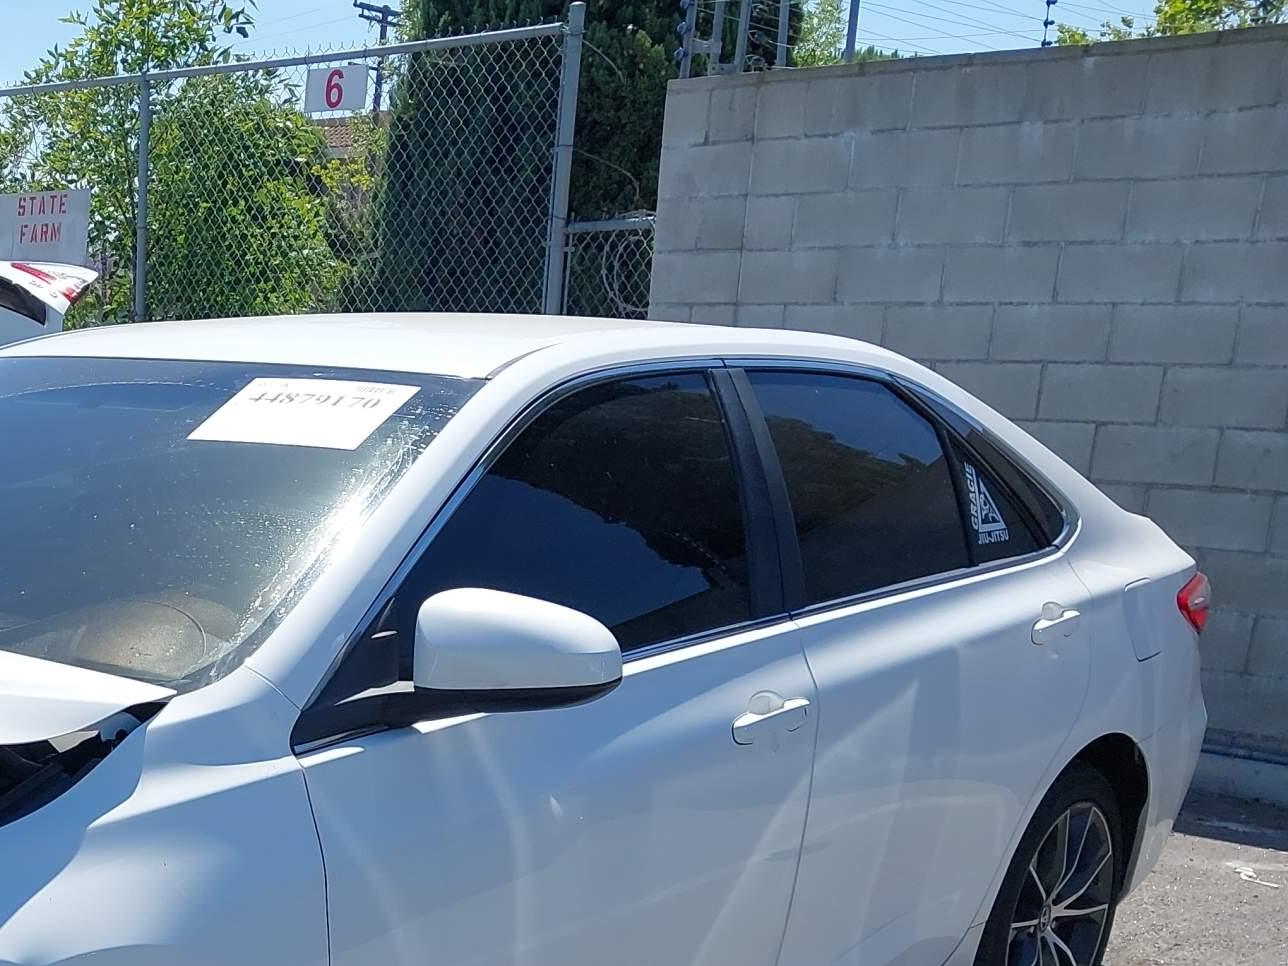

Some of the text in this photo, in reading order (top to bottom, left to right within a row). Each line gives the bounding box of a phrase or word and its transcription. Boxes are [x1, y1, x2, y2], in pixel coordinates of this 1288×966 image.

[325, 69, 344, 109] 6
[18, 194, 68, 217] STATE
[19, 222, 62, 244] FARM
[248, 391, 382, 409] 44879170
[964, 461, 978, 531] GRACIE
[978, 529, 1009, 544] JIU-JITSU
